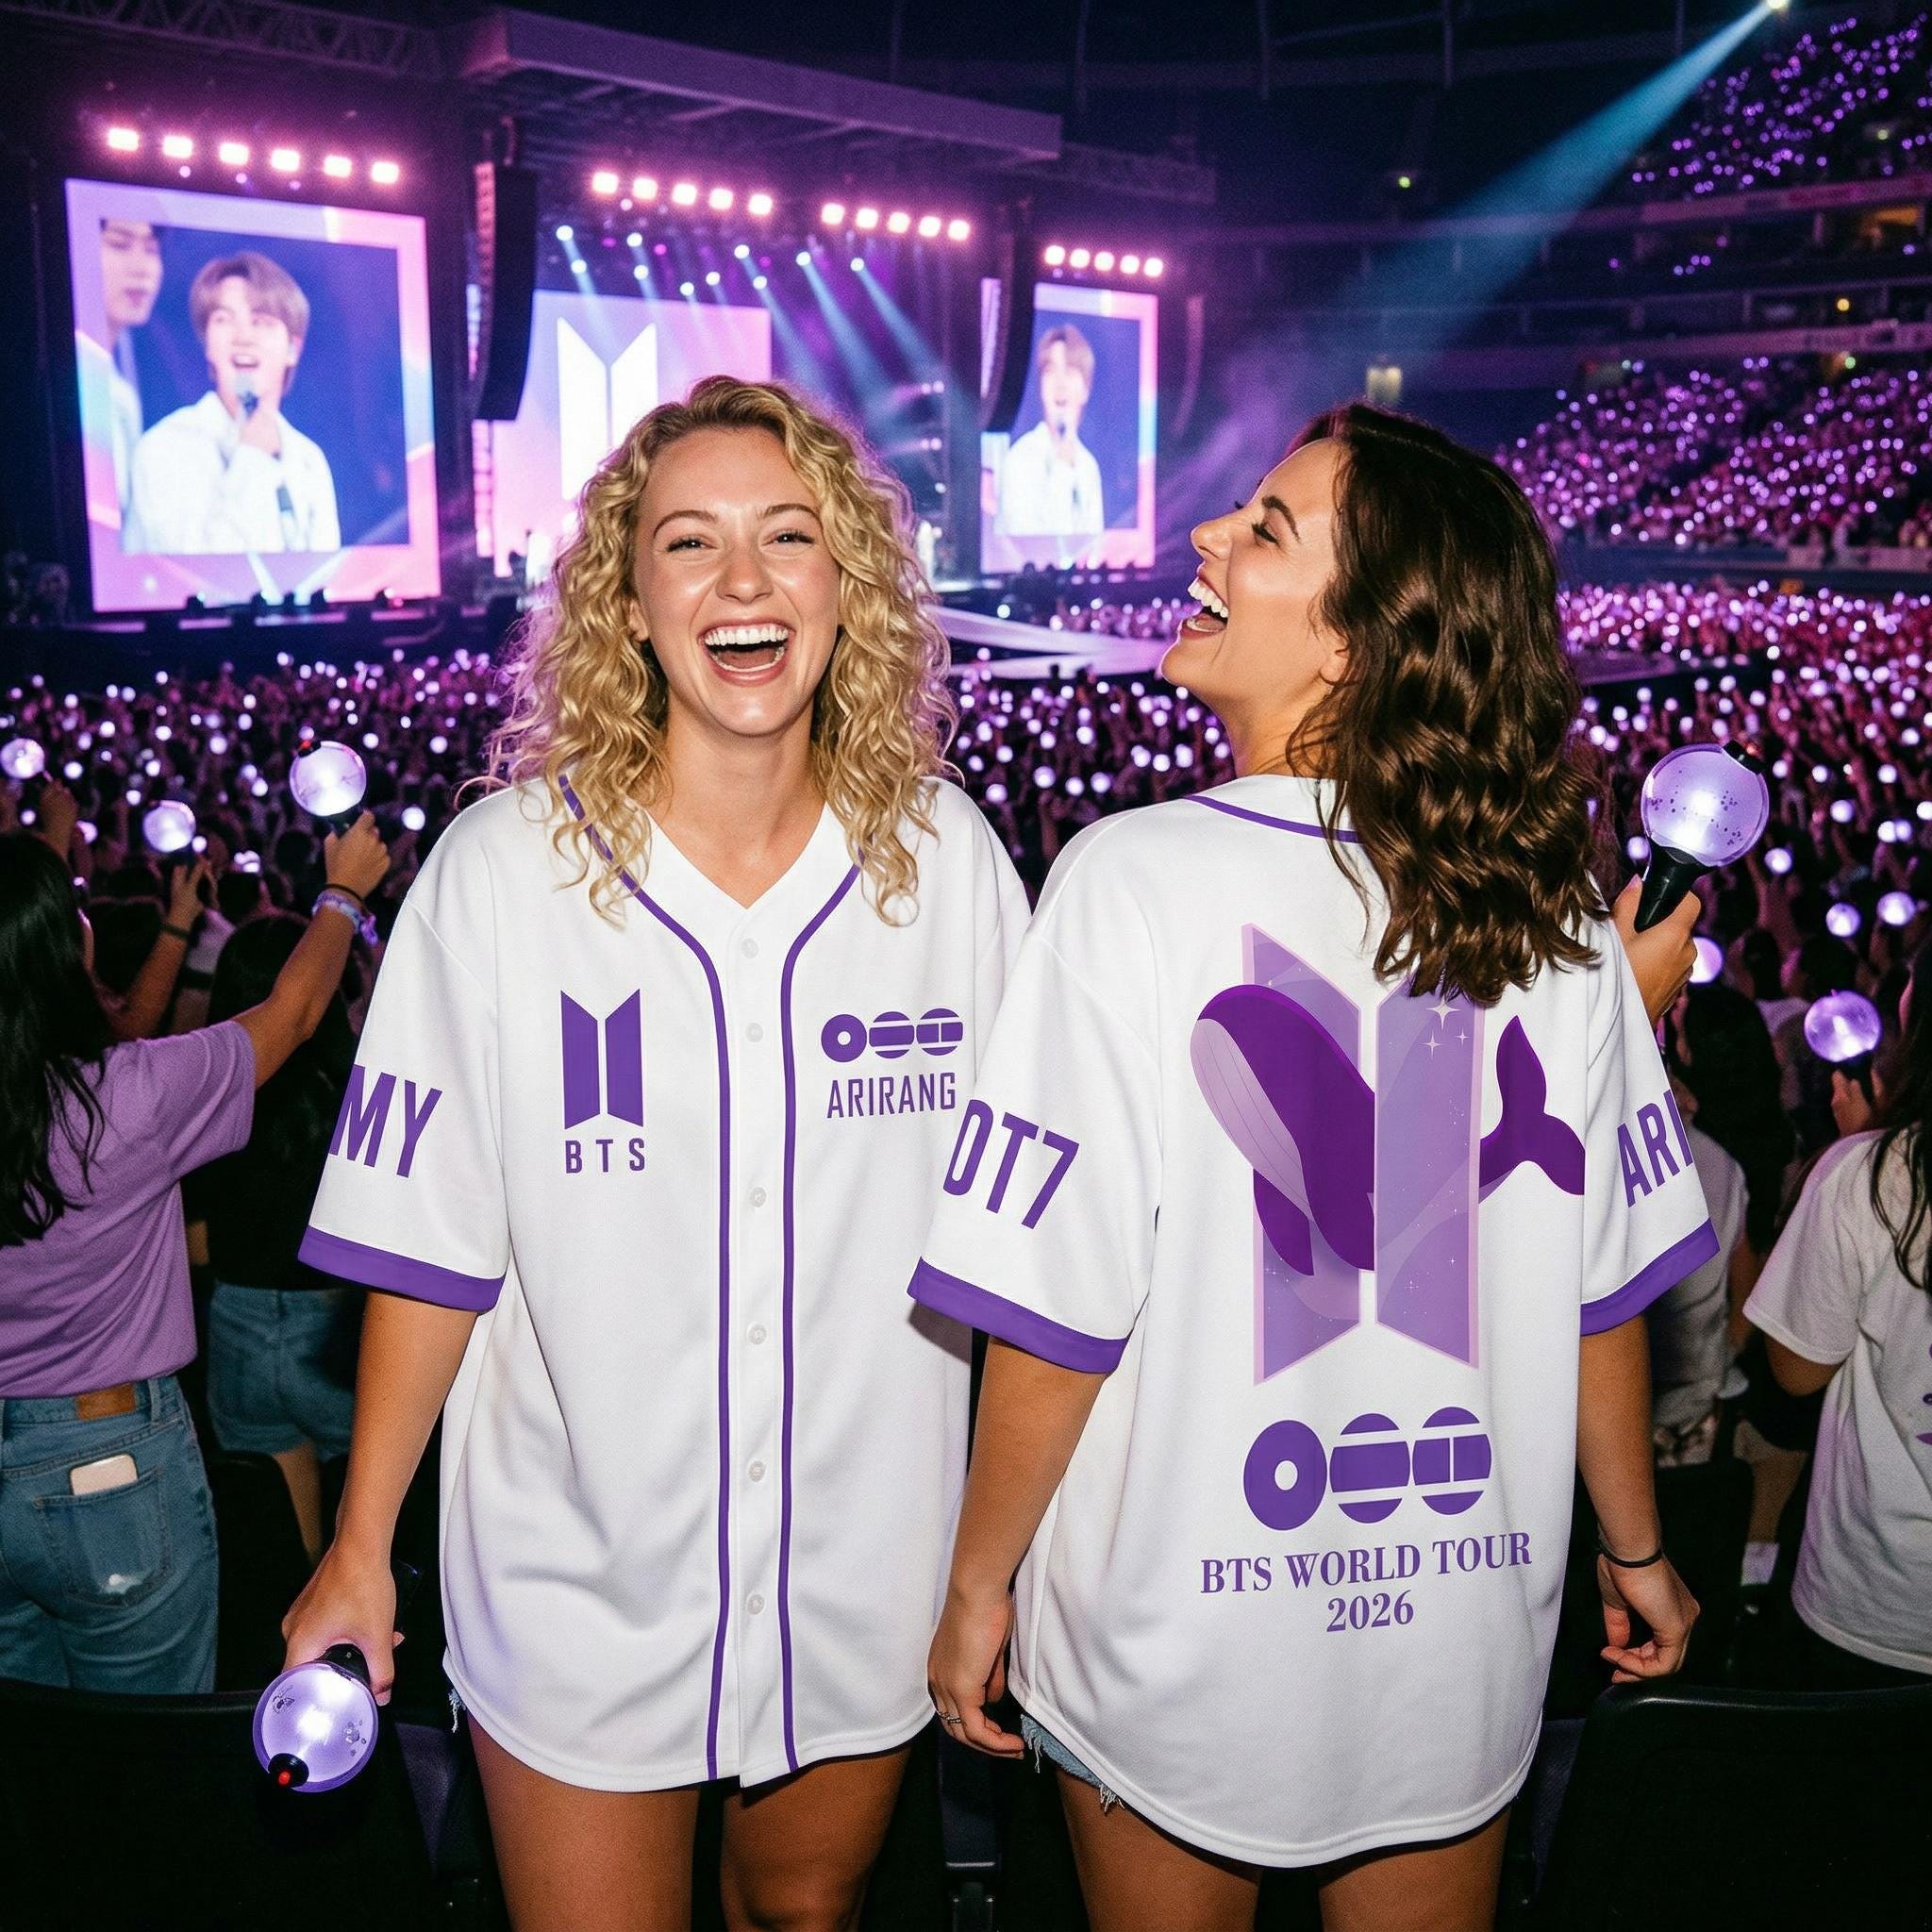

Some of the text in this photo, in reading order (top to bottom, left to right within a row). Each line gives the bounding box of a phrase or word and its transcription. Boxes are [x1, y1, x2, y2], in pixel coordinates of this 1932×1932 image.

[328, 1063, 443, 1178] MY
[826, 1072, 956, 1119] ARIRANG
[564, 1138, 645, 1174] BTS
[942, 1099, 1080, 1229] OT7
[1616, 1089, 1693, 1208] ARI
[1200, 1532, 1533, 1594] BTS WORLD TOUR
[1326, 1590, 1414, 1633] 2026
